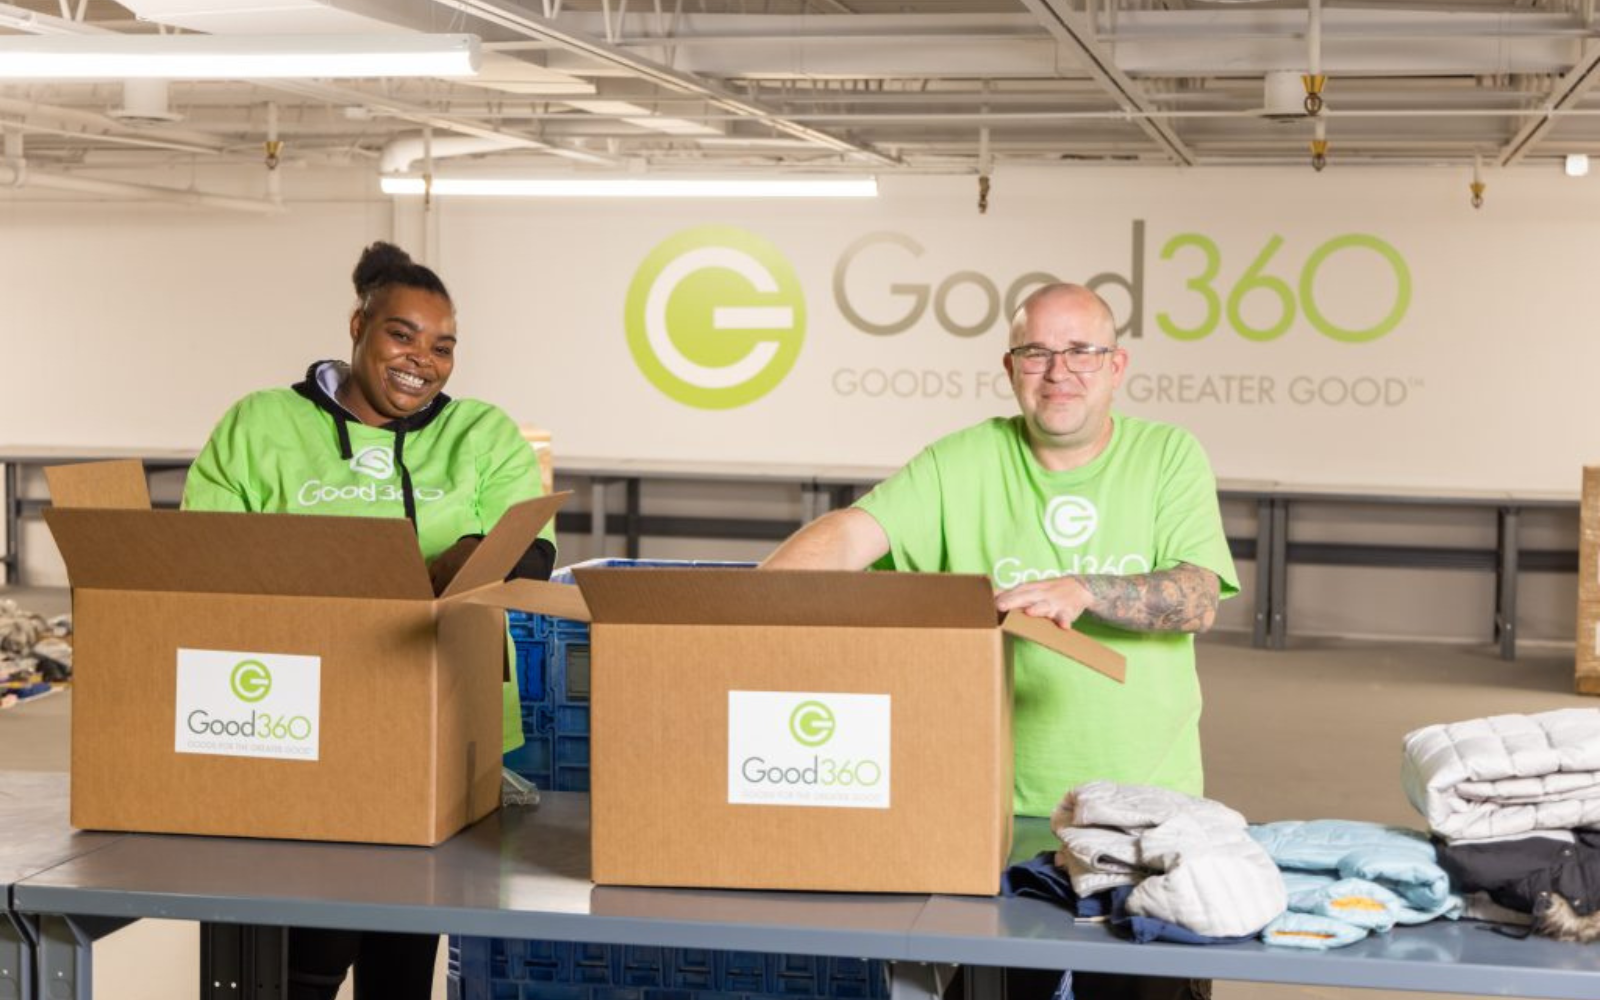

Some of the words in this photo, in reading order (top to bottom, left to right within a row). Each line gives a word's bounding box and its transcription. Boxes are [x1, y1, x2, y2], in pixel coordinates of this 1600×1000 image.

[831, 367, 963, 399] GOODS
[975, 370, 1014, 400] FO
[1126, 374, 1276, 405] GREATER
[187, 709, 312, 741] Good360
[741, 754, 882, 787] Good360
